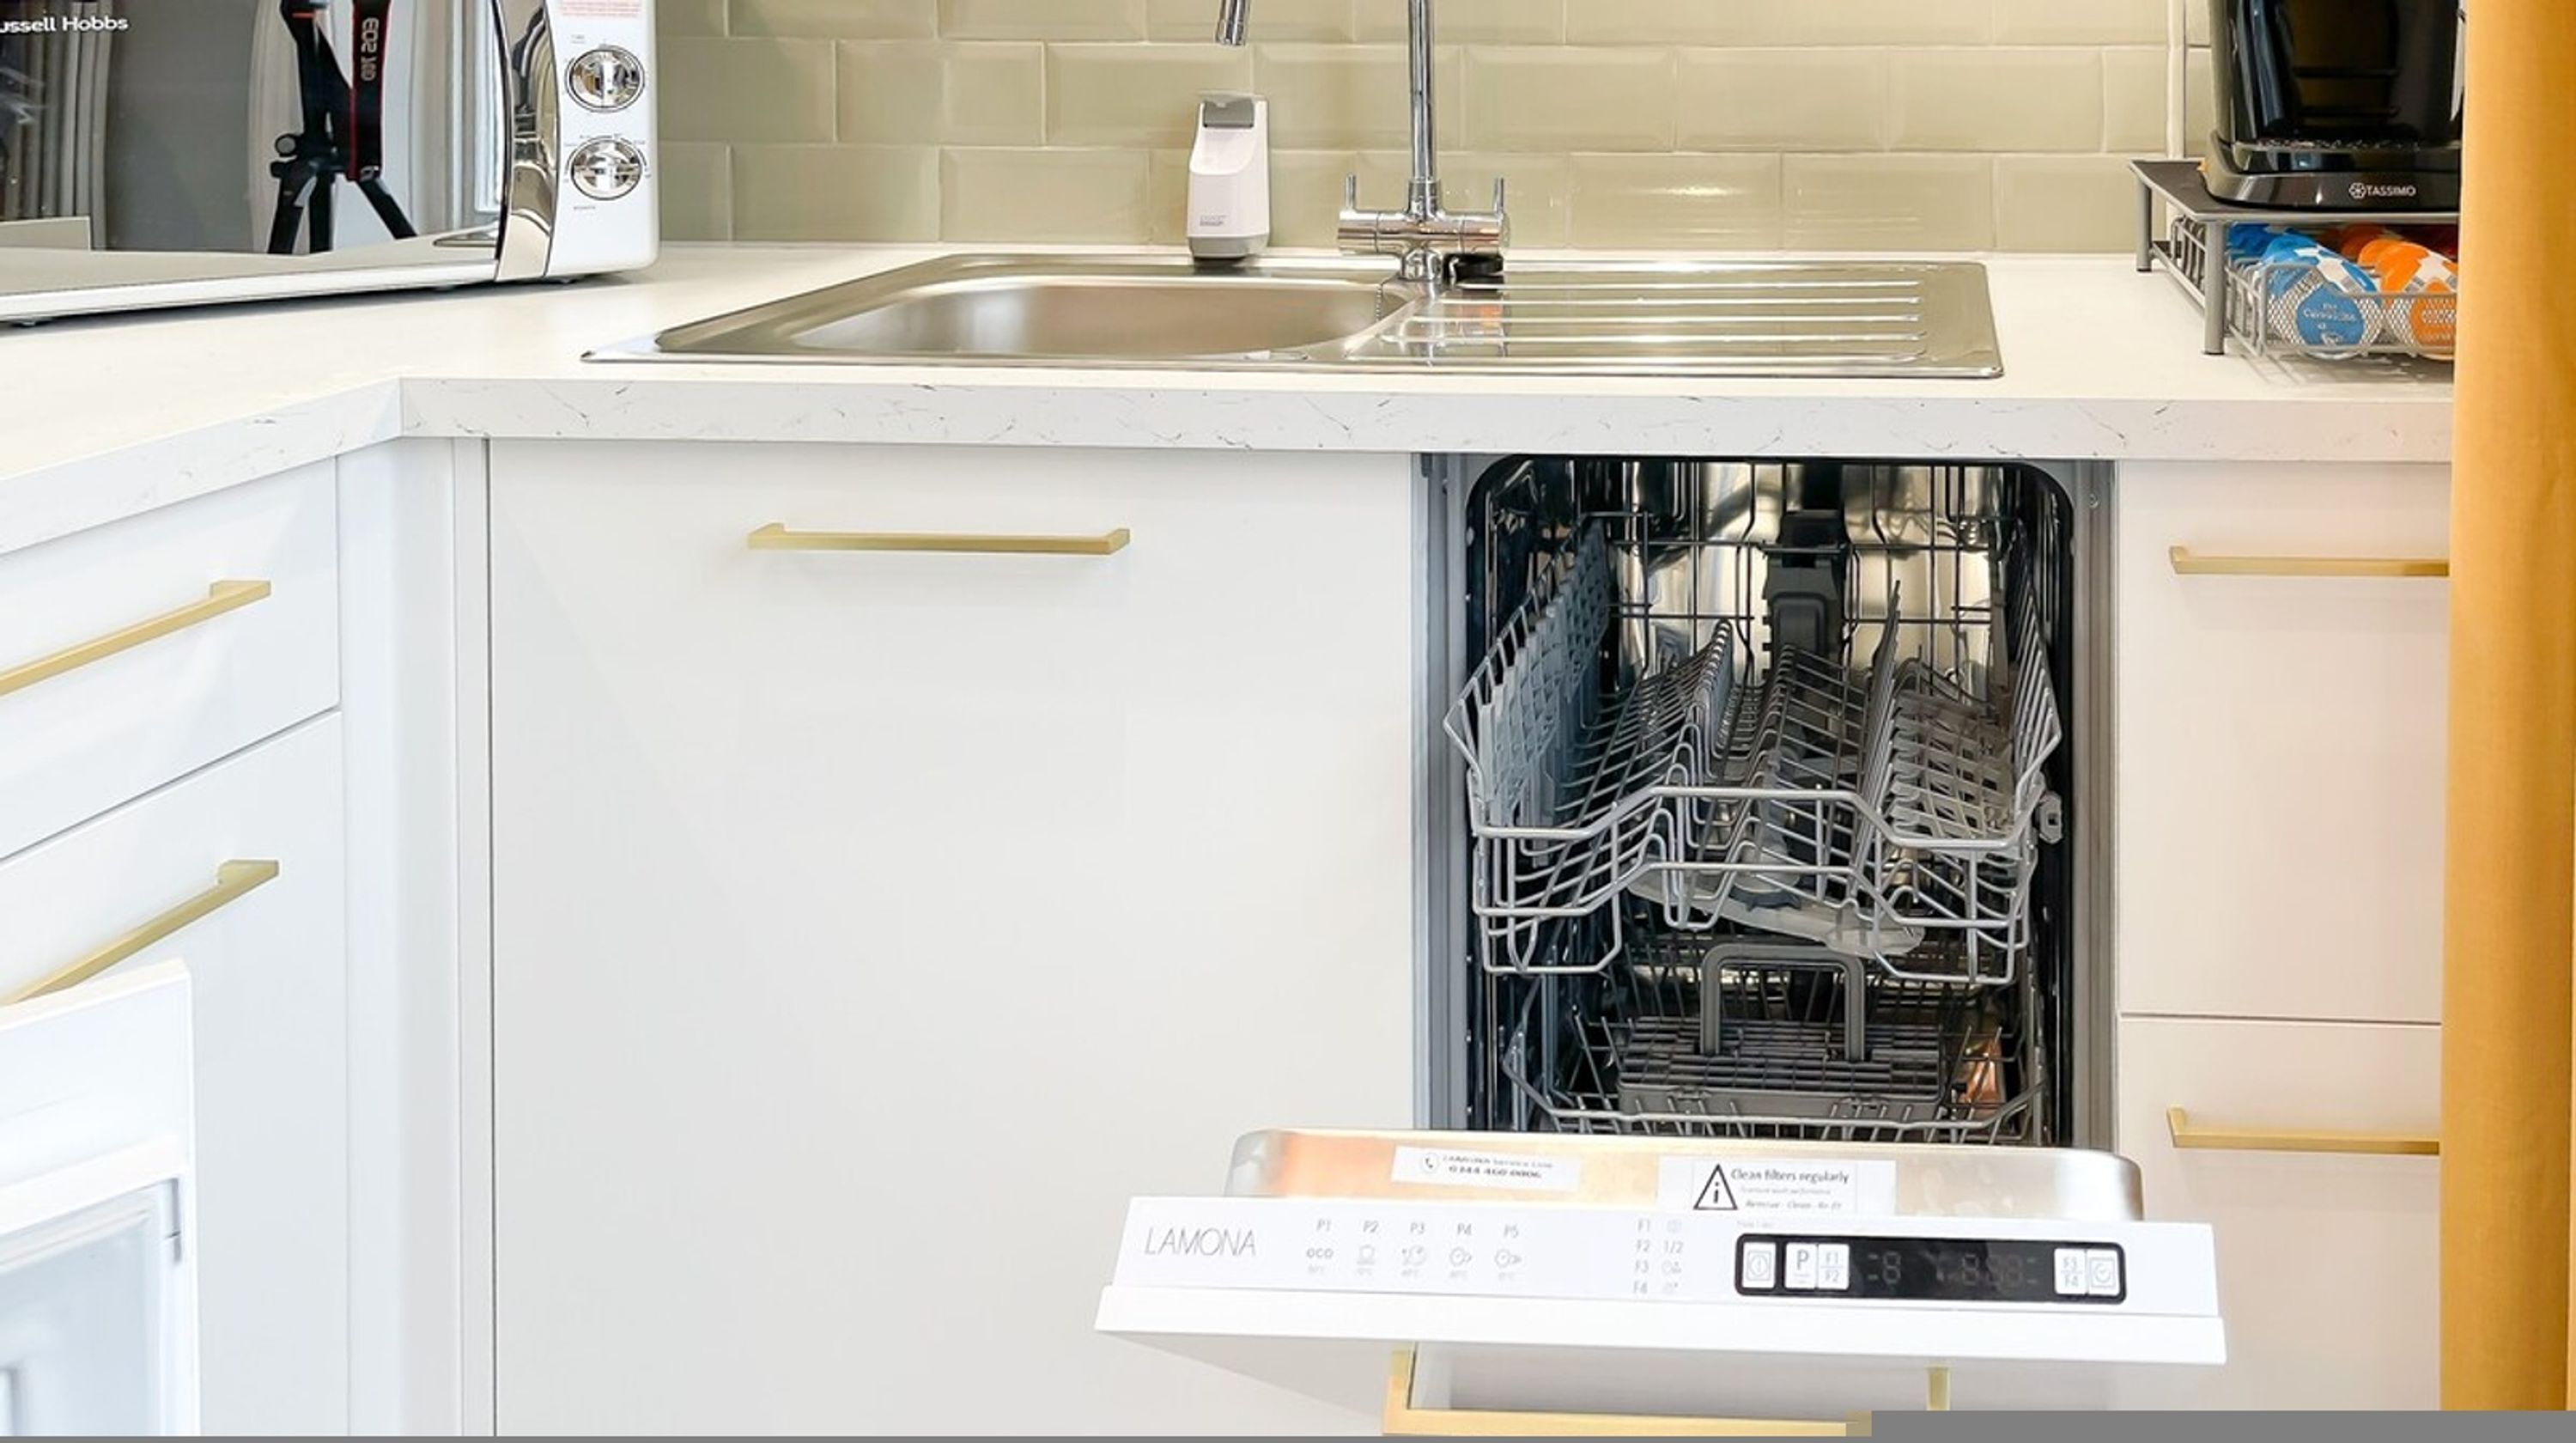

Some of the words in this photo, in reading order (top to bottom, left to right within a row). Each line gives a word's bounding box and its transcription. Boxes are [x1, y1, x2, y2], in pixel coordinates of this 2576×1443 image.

[62, 15, 129, 31] Hobbs
[2366, 184, 2417, 197] TASSIMO
[1730, 1168, 1763, 1181] Clean
[1765, 1169, 1797, 1182] filters
[1799, 1172, 1850, 1184] regularly
[1363, 1220, 1379, 1233] P2
[1410, 1221, 1425, 1234] P3
[1456, 1223, 1472, 1236] P4
[1145, 1227, 1256, 1257] LAMONA
[1636, 1239, 1649, 1252] F2
[1664, 1239, 1684, 1254] 1/2
[1796, 1249, 1809, 1271] P
[1633, 1280, 1648, 1294] F4
